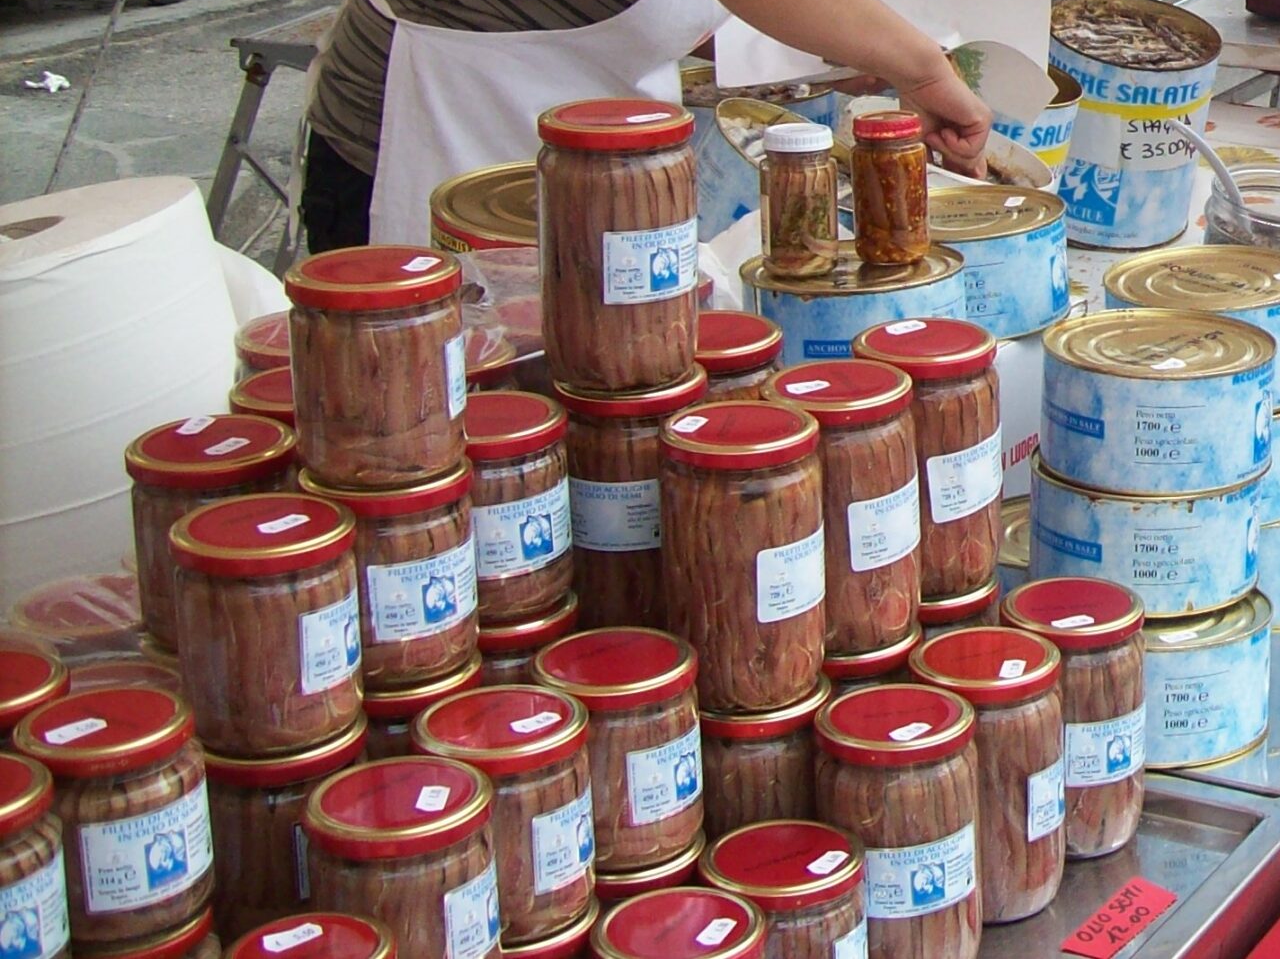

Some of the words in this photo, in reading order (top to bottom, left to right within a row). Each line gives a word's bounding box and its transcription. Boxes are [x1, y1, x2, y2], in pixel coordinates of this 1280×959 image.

[1115, 81, 1201, 105] SALATE
[1029, 121, 1073, 147] SALA
[808, 344, 853, 353] ANCHOVI
[1079, 419, 1101, 431] SALT
[1135, 421, 1161, 432] 1700
[1010, 432, 1039, 467] LUOGO
[1135, 448, 1159, 458] 1000
[487, 504, 521, 516] FILETTI
[500, 513, 512, 521] IN
[513, 509, 537, 520] OLIO
[1074, 543, 1098, 556] SALT
[1133, 544, 1159, 554] 1700
[1132, 569, 1158, 580] 1000
[1165, 693, 1190, 703] 1700
[1164, 719, 1189, 730] 1000
[102, 818, 146, 836] FILETTI
[118, 832, 132, 842] IN
[135, 823, 166, 838] OLIO
[890, 859, 902, 867] IN
[903, 855, 929, 866] OLIO
[1108, 885, 1143, 914] SEMI
